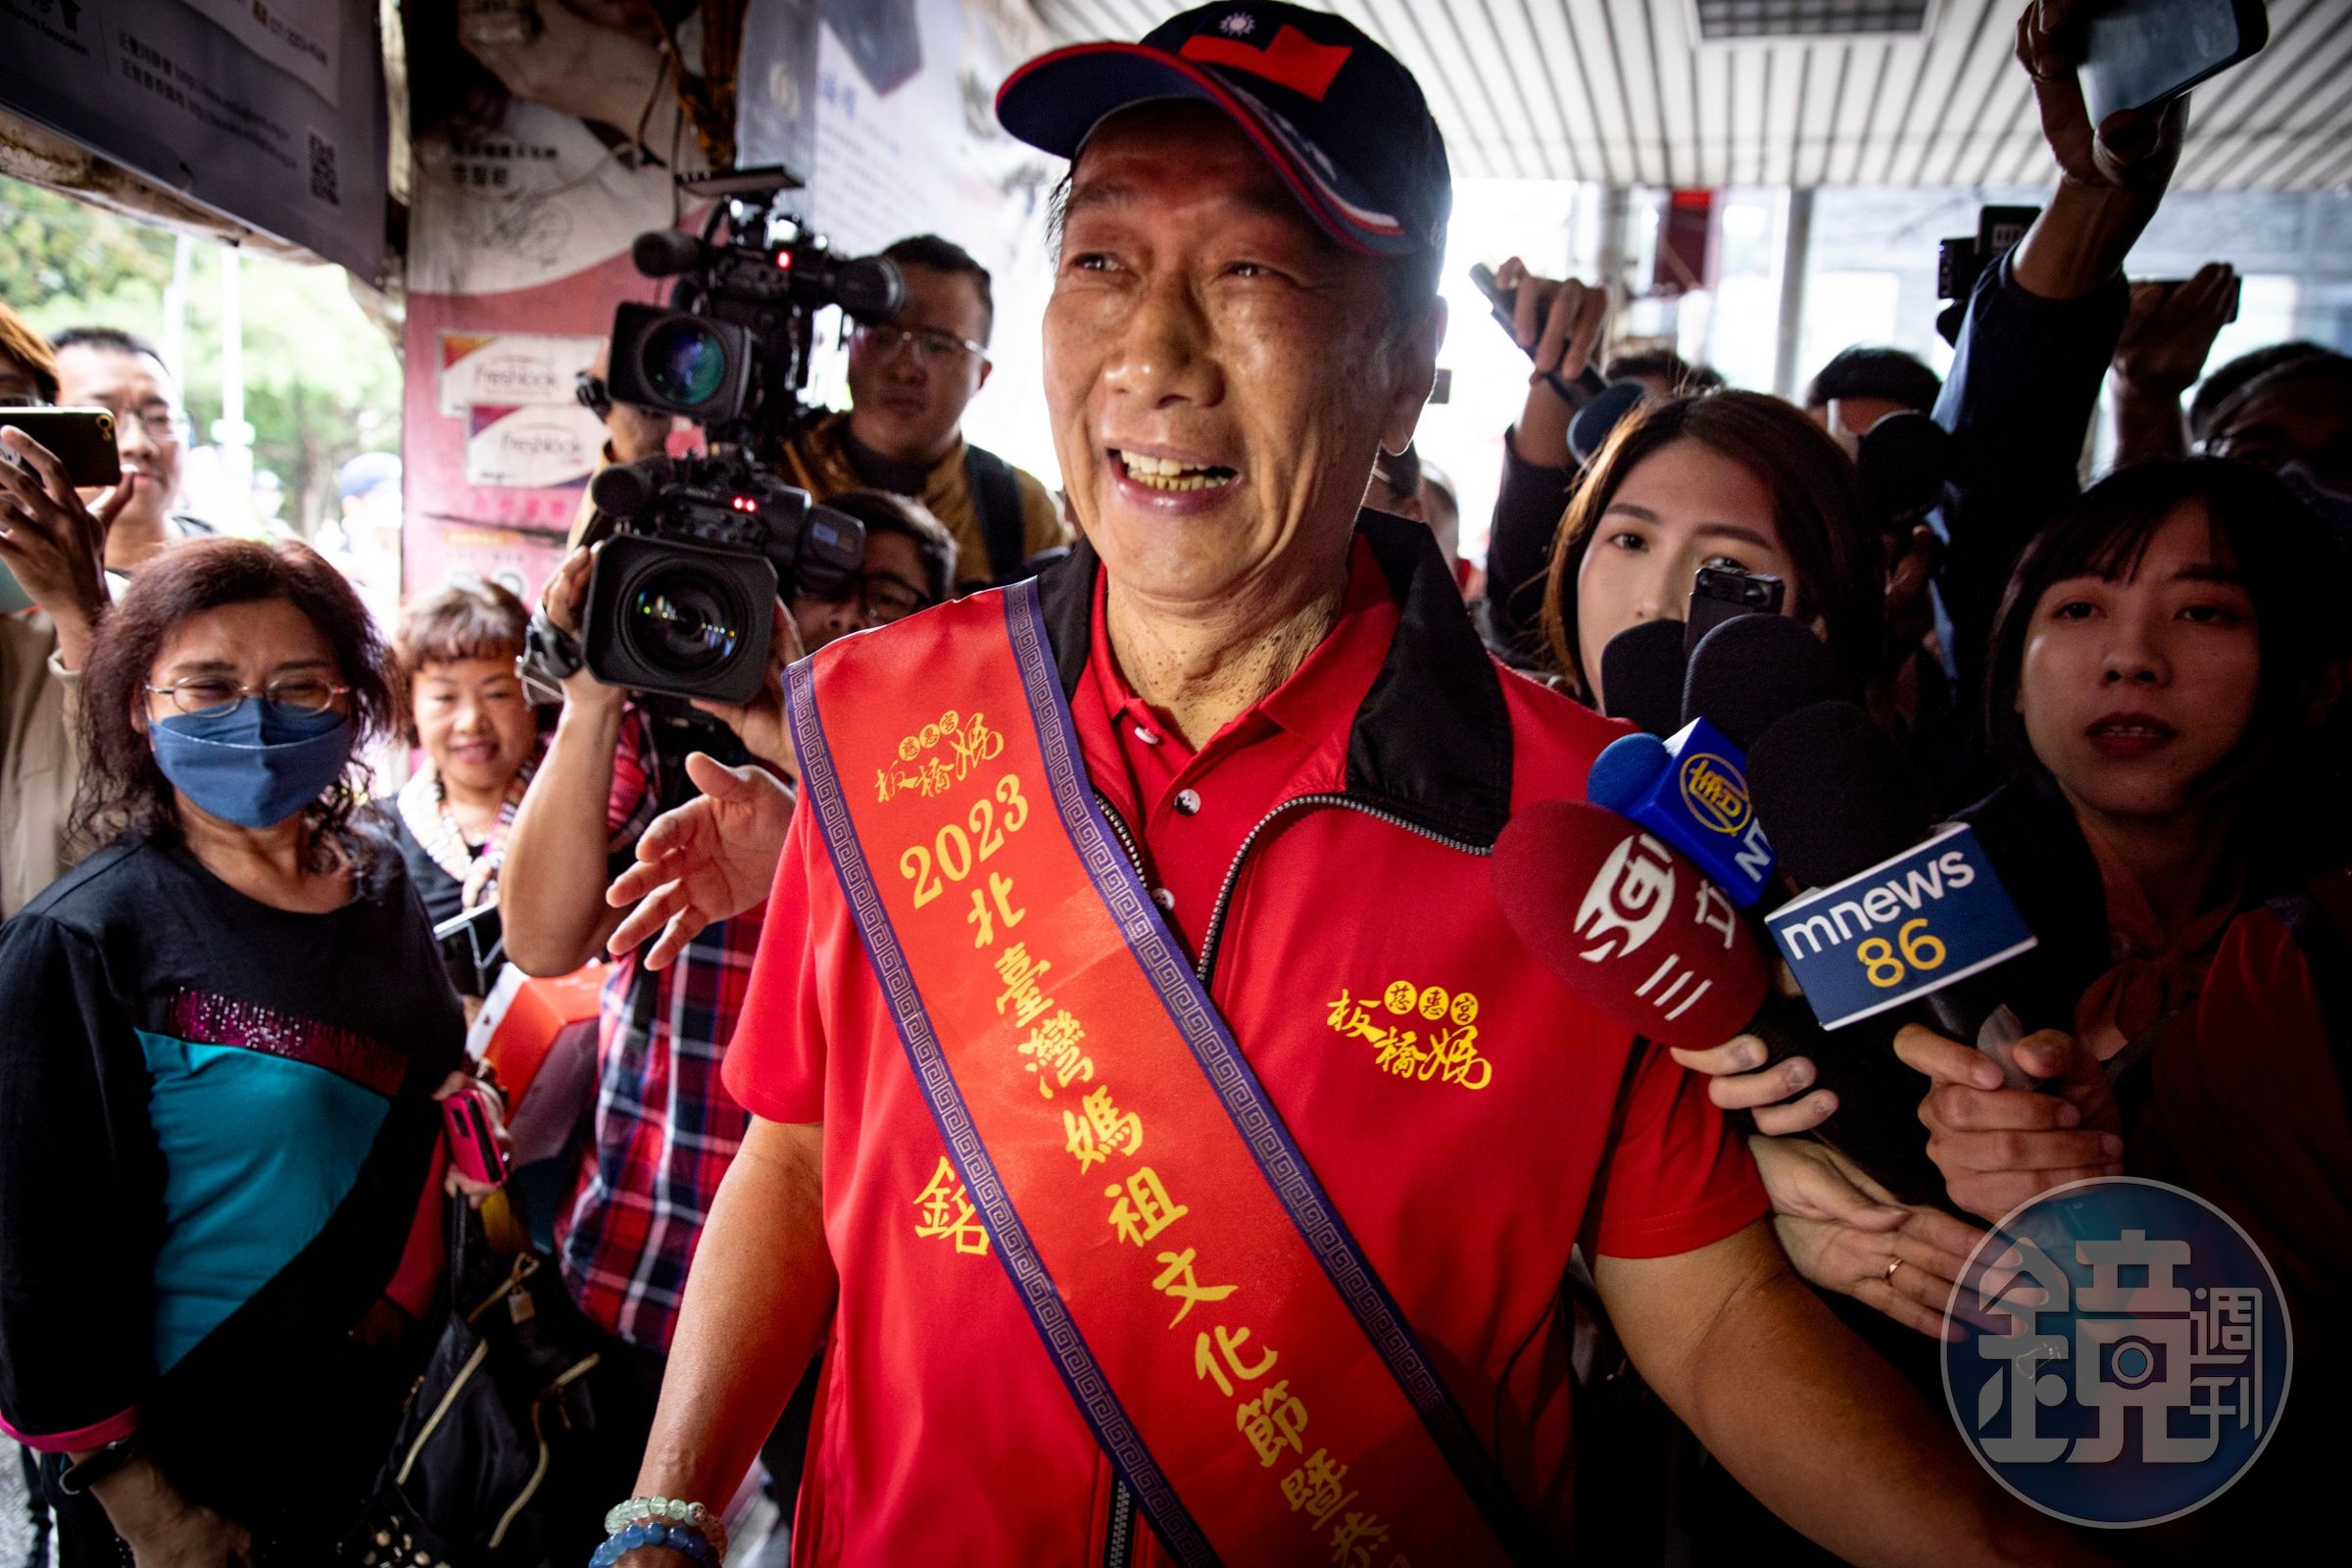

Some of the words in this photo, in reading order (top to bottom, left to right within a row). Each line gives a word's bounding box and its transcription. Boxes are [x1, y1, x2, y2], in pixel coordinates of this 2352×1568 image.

[900, 773, 1029, 910] 2023
[1781, 851, 1976, 960] mnews
[1856, 917, 1947, 989] 86
